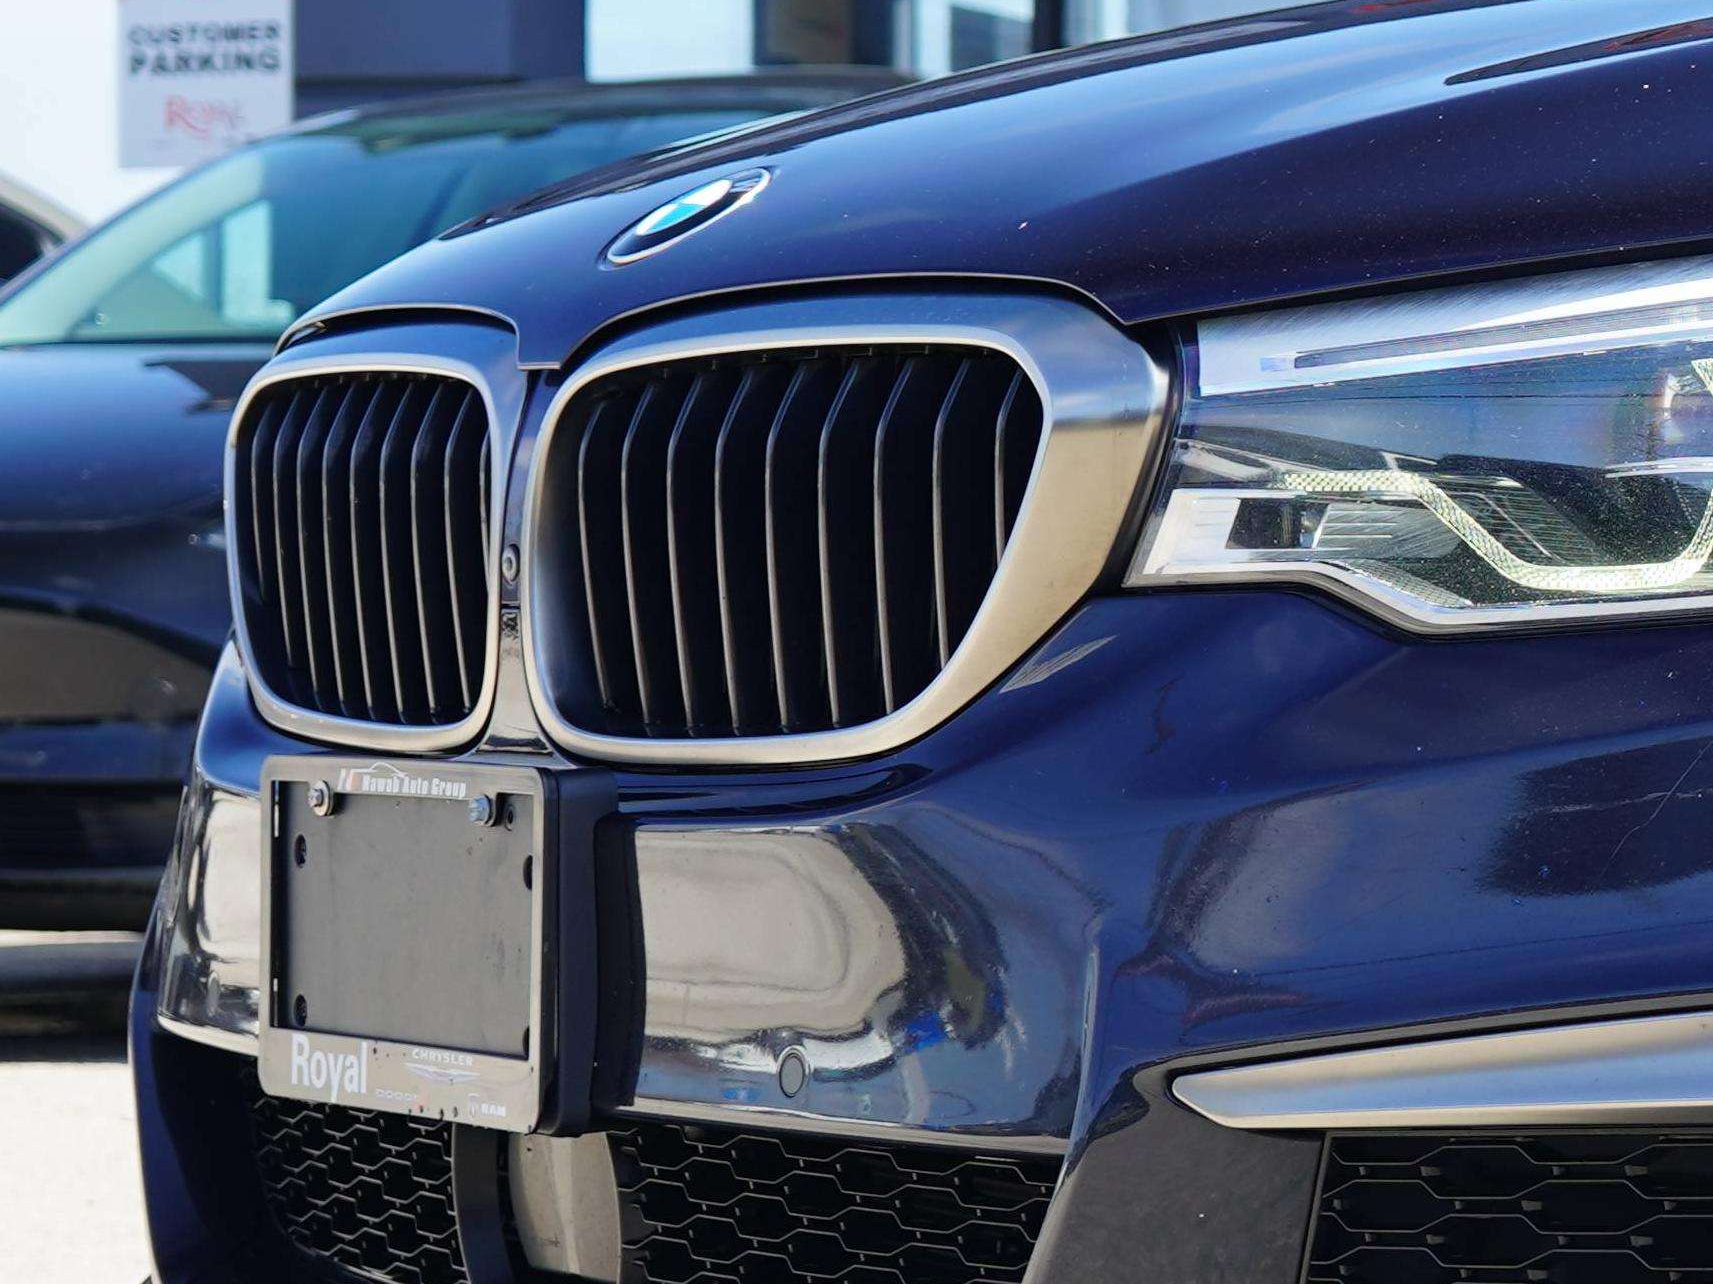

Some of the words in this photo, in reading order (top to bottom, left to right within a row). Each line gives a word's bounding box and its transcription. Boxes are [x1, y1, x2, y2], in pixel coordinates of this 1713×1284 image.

[128, 21, 280, 46] CUSTOMER
[128, 47, 280, 76] PARKING
[290, 1033, 367, 1103] Royal
[412, 1047, 474, 1067] CHRYSLER
